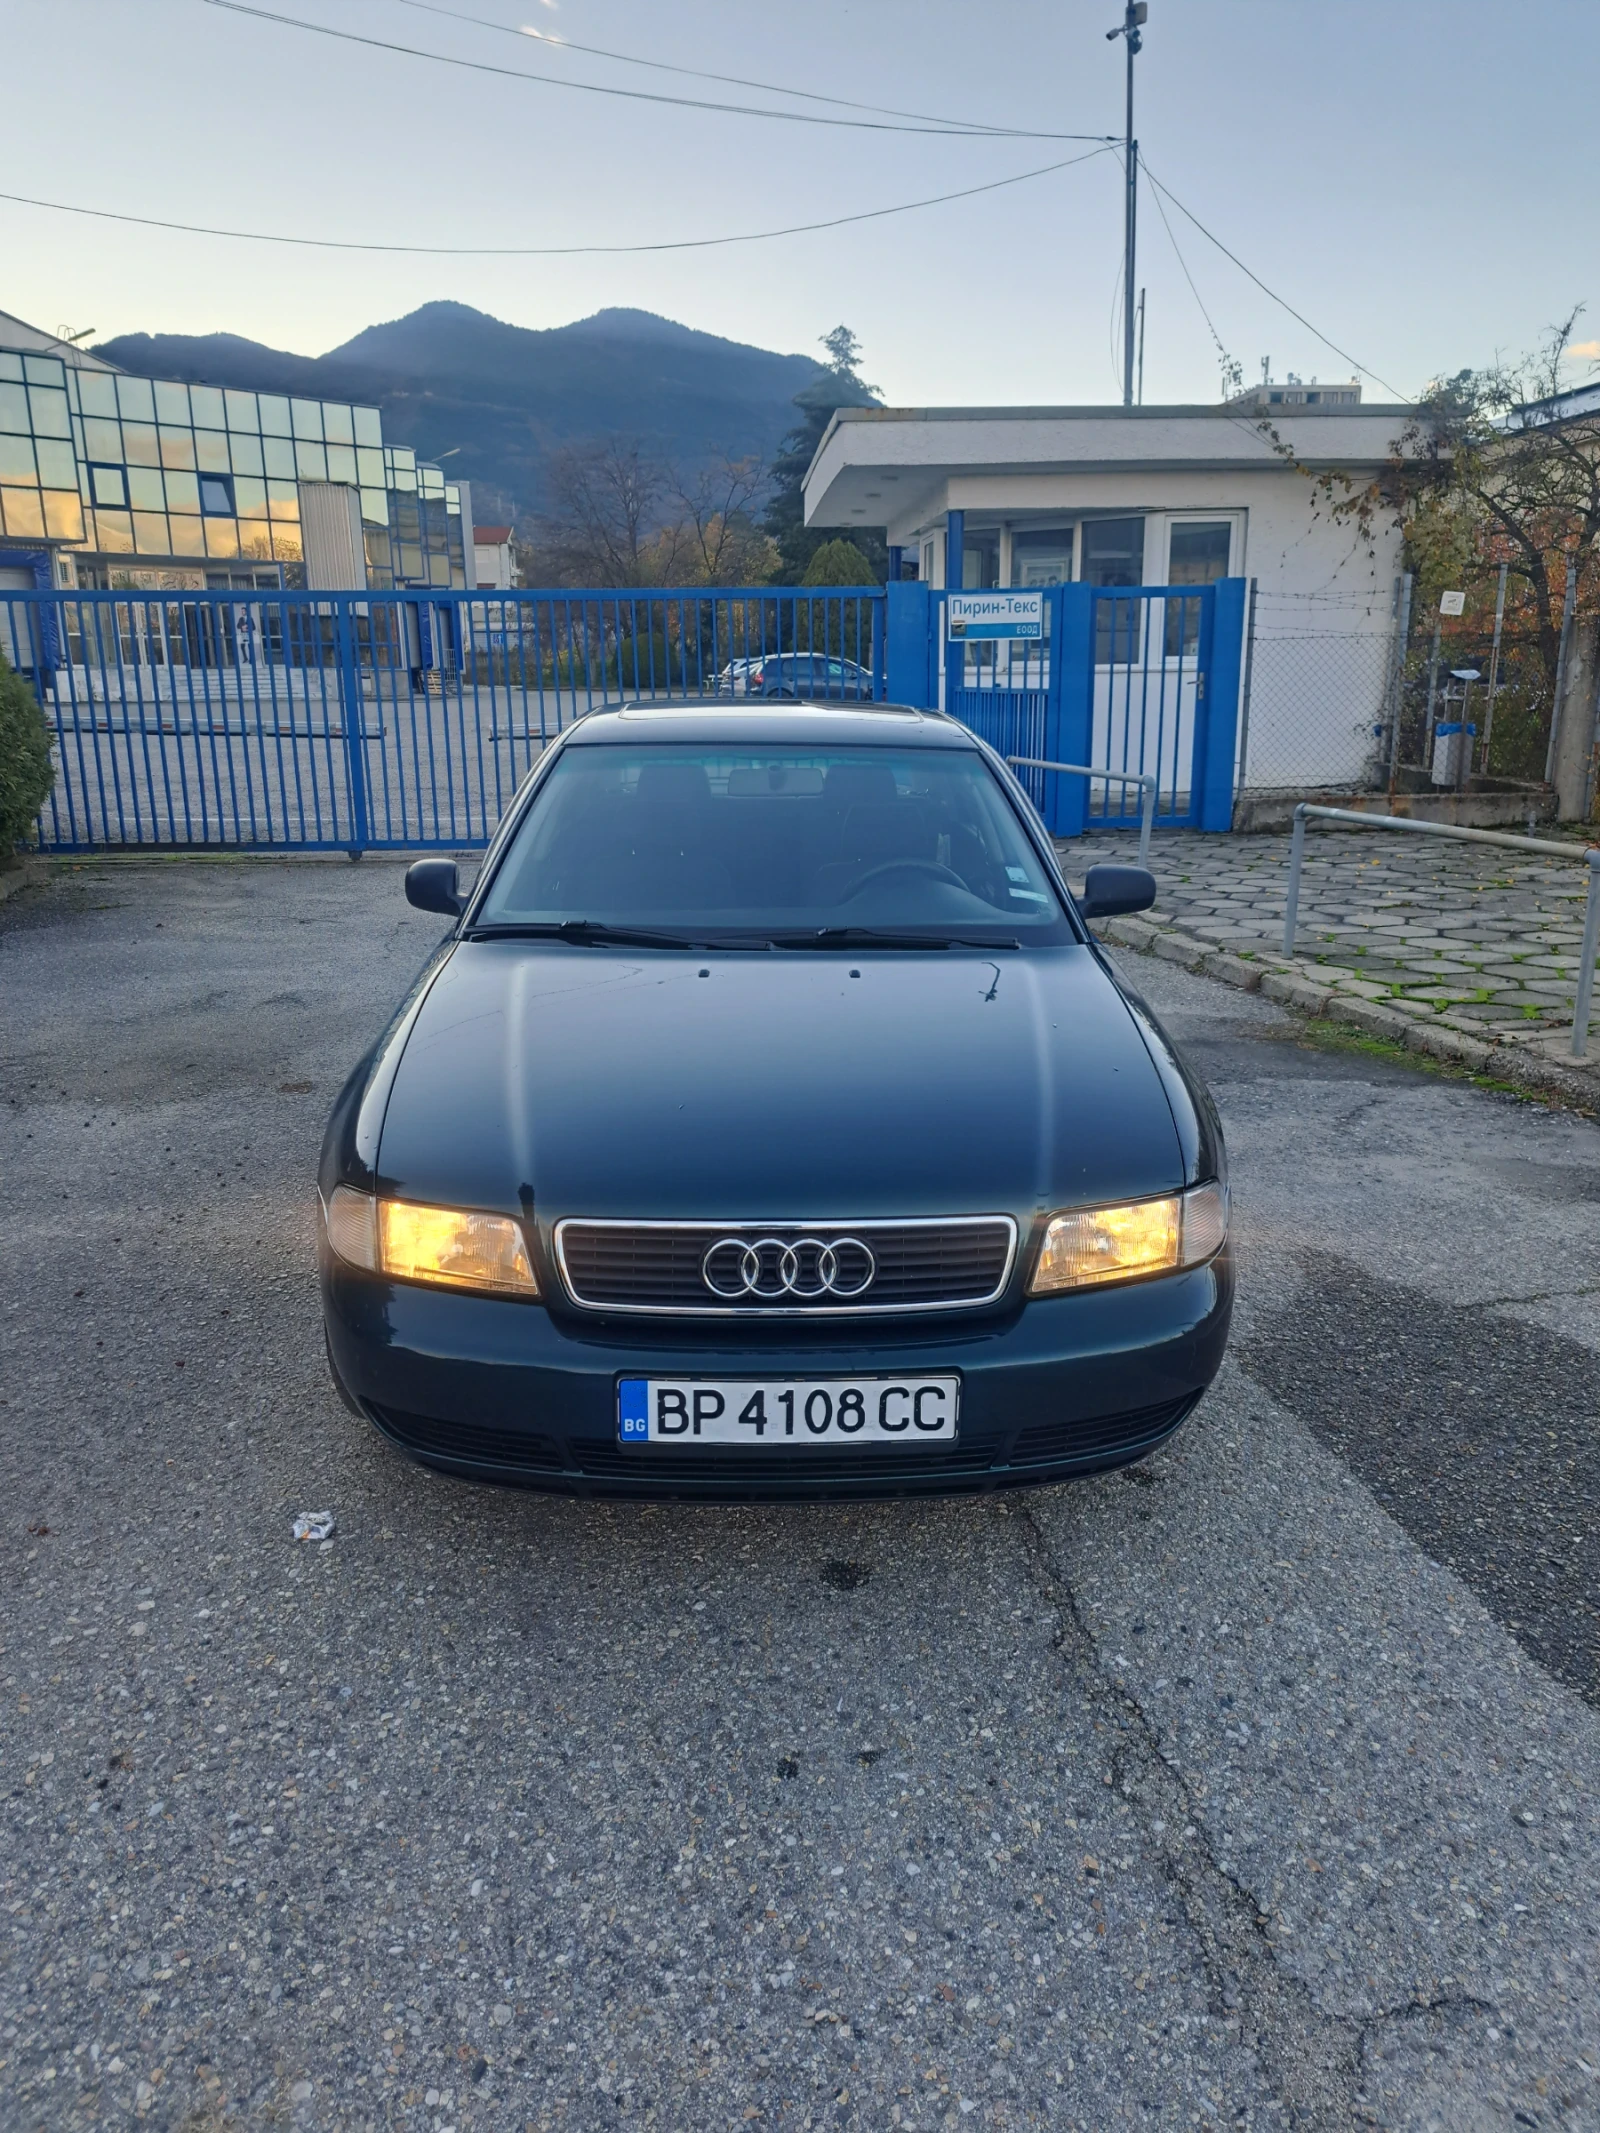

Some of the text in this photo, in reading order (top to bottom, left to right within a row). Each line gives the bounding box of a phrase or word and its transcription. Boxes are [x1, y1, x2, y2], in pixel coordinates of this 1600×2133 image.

[952, 598, 1038, 618] Пирин-Текс
[1016, 625, 1038, 635] ЕООД
[657, 1386, 946, 1435] BP 4108 CC
[624, 1418, 646, 1433] BG
